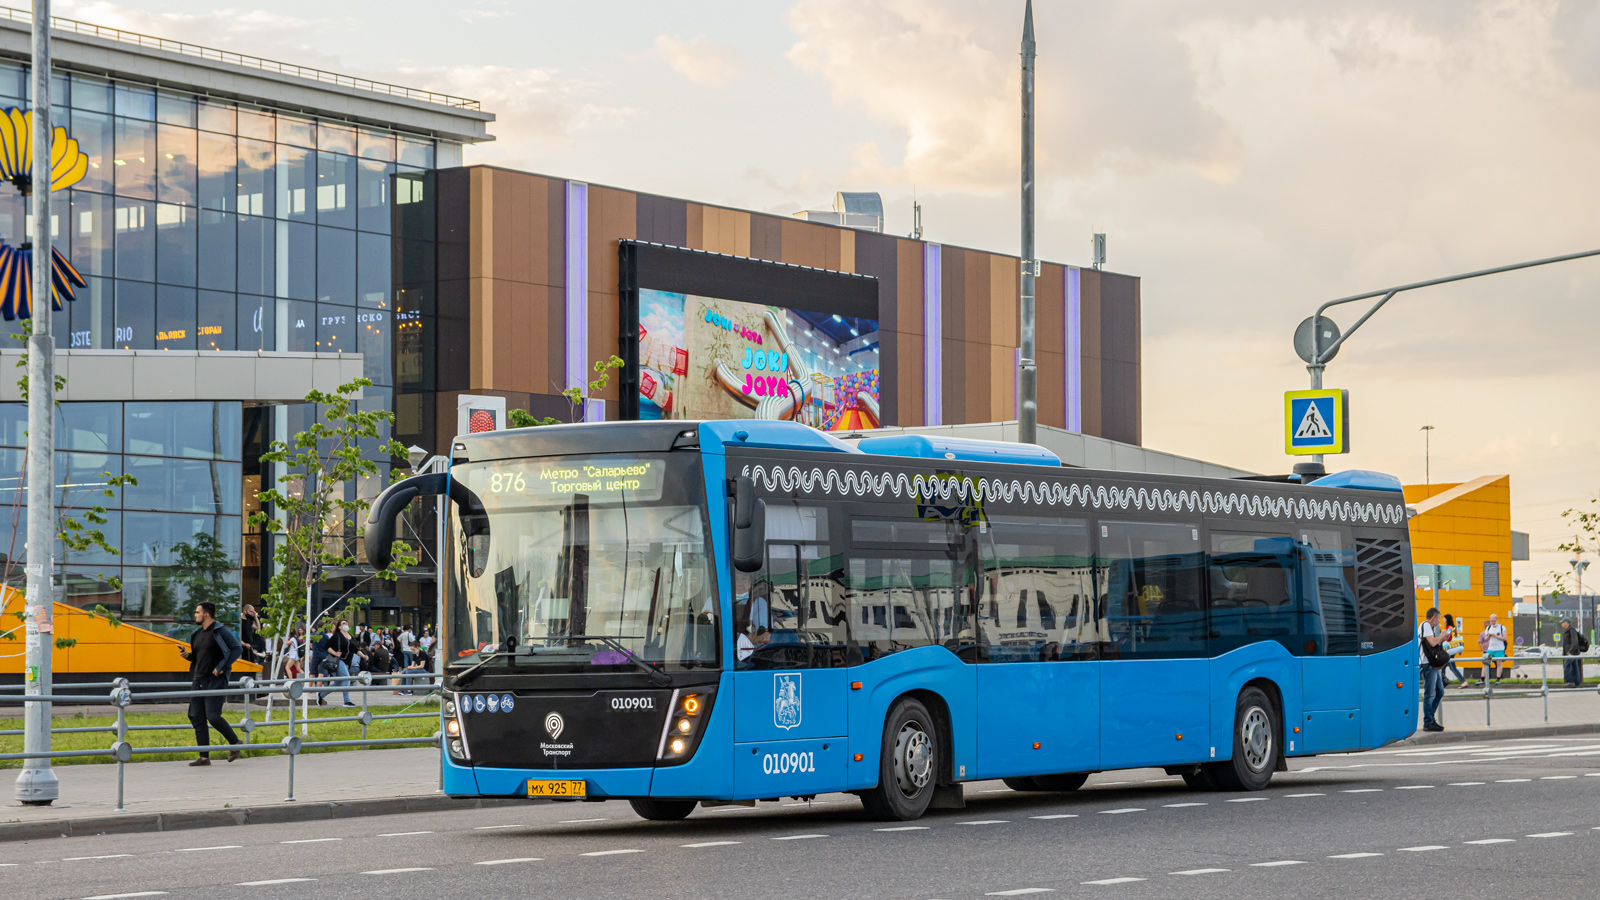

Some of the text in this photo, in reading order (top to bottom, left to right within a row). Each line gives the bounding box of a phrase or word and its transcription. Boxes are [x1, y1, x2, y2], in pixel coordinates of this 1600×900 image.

[704, 309, 763, 345] JOKI JOYA
[741, 347, 788, 373] JOKI
[741, 373, 788, 398] JOYA
[540, 463, 650, 480] Метро "Саларьево"
[491, 472, 526, 493] 876
[550, 479, 640, 493] Торговый центр
[611, 697, 654, 709] 010901
[763, 752, 815, 775] 010901
[548, 781, 567, 795] 925
[572, 781, 582, 791] 77
